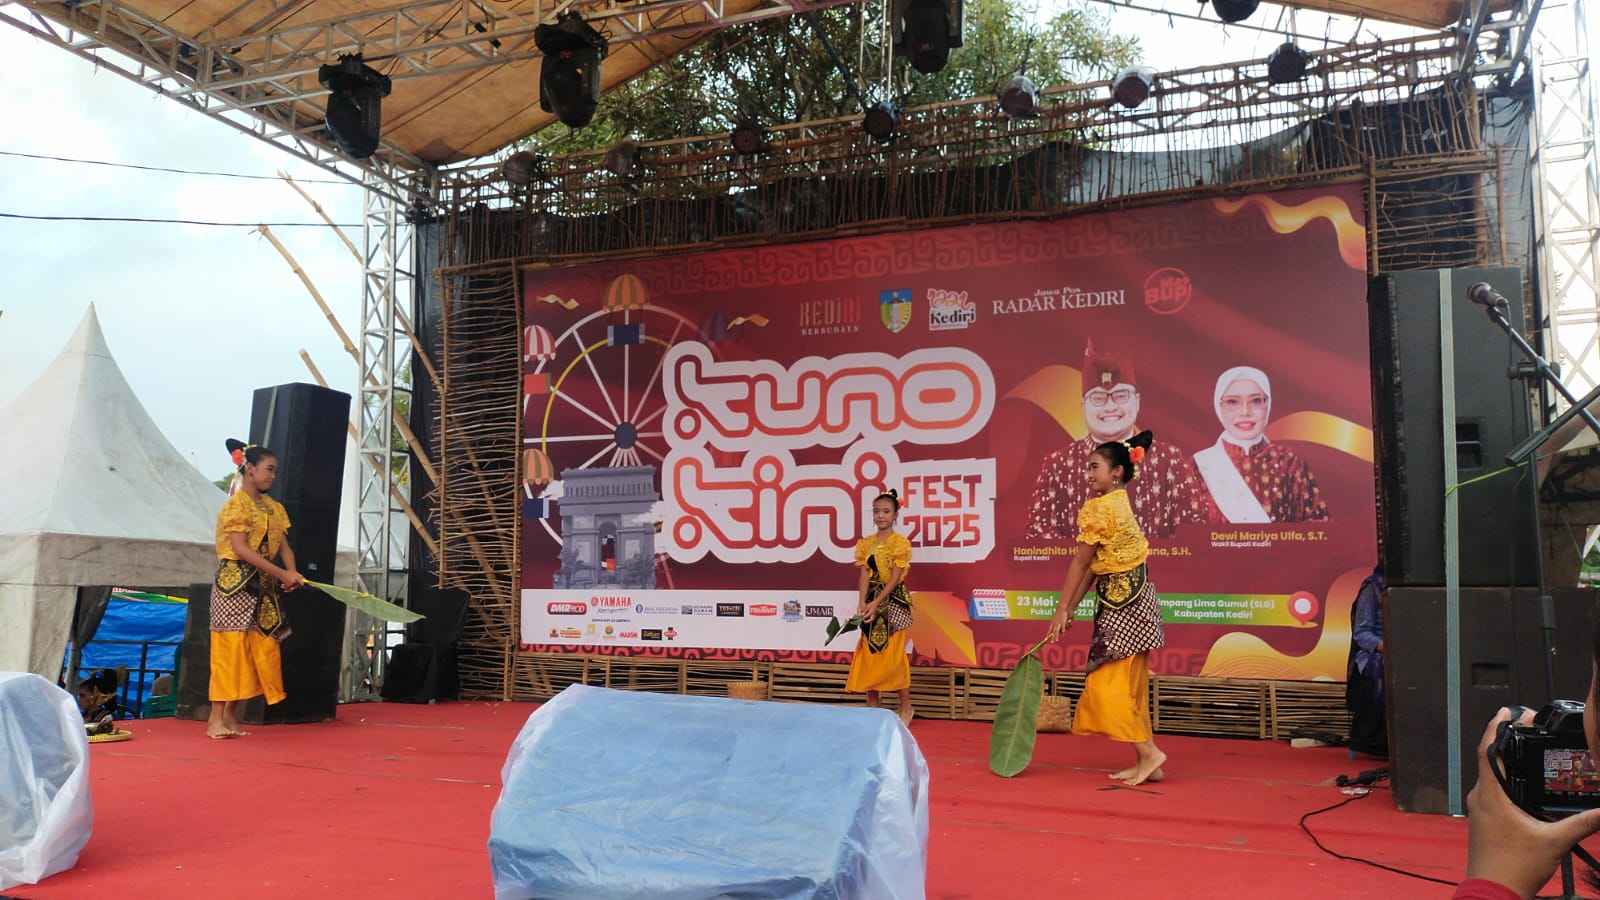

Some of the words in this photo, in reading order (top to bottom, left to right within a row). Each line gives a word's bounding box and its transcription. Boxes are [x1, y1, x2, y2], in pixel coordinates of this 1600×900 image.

[1034, 289, 1060, 297] Jawa
[1063, 287, 1081, 295] Pos
[992, 297, 1055, 315] RADAR
[1061, 289, 1126, 309] KEDIRI
[930, 308, 975, 325] Kediri
[801, 324, 860, 337] BERBUDAYA
[903, 474, 982, 510] FEST
[903, 513, 981, 549] 2025
[1211, 531, 1238, 541] Dewi
[1239, 531, 1278, 544] Mariya
[1280, 531, 1306, 543] Ulfa,
[1308, 531, 1328, 541] S.T.
[1014, 546, 1067, 556] Hanindhito
[1171, 546, 1192, 556] S.H.
[1230, 541, 1251, 549] Bupati
[600, 596, 632, 607] YAMAHA
[1016, 595, 1030, 606] 23
[1032, 595, 1054, 607] Mei
[1157, 597, 1192, 608] impang
[1194, 598, 1216, 608] Lima
[1217, 599, 1248, 609] Gumul
[1250, 599, 1275, 610] (SLG)
[1030, 607, 1052, 616] Pukul
[1174, 609, 1224, 620] Kabupaten
[1226, 609, 1253, 619] Kediri
